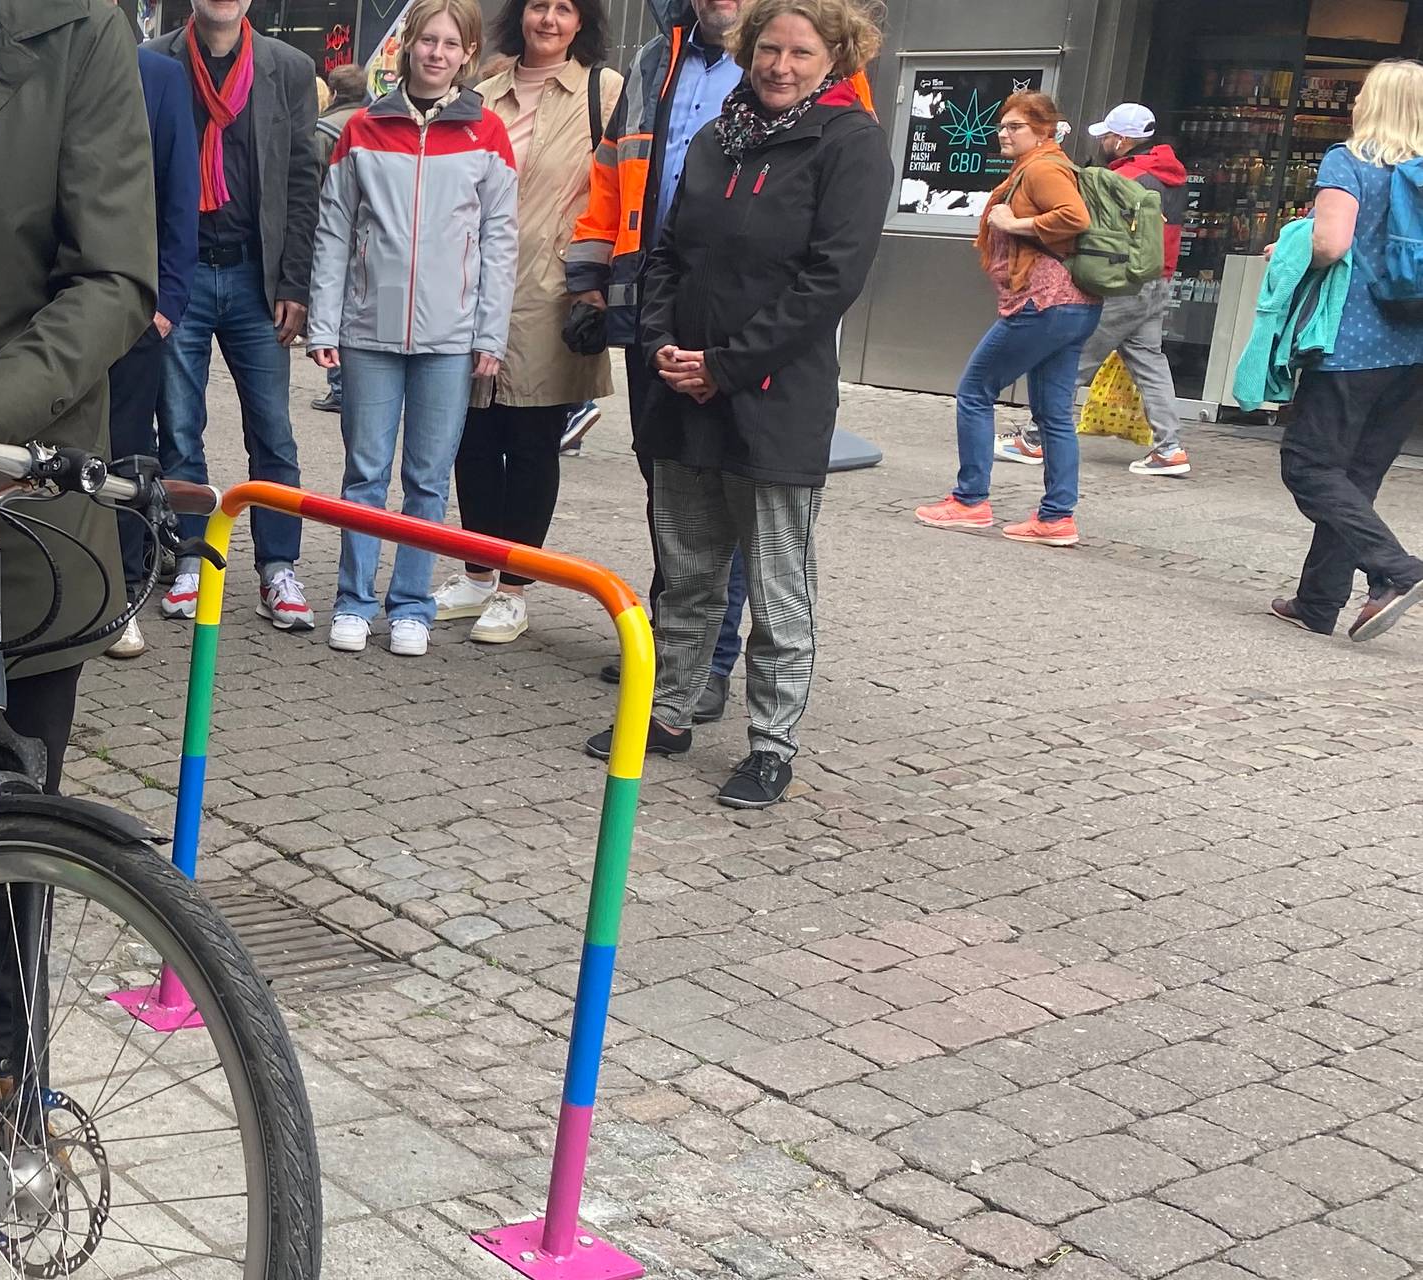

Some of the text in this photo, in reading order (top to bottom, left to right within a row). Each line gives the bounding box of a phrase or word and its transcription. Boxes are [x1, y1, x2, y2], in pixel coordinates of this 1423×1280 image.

[912, 142, 937, 152] BLÜTEN
[910, 152, 930, 161] HASH
[909, 161, 941, 172] EXTRAKTE
[949, 152, 981, 173] CBD
